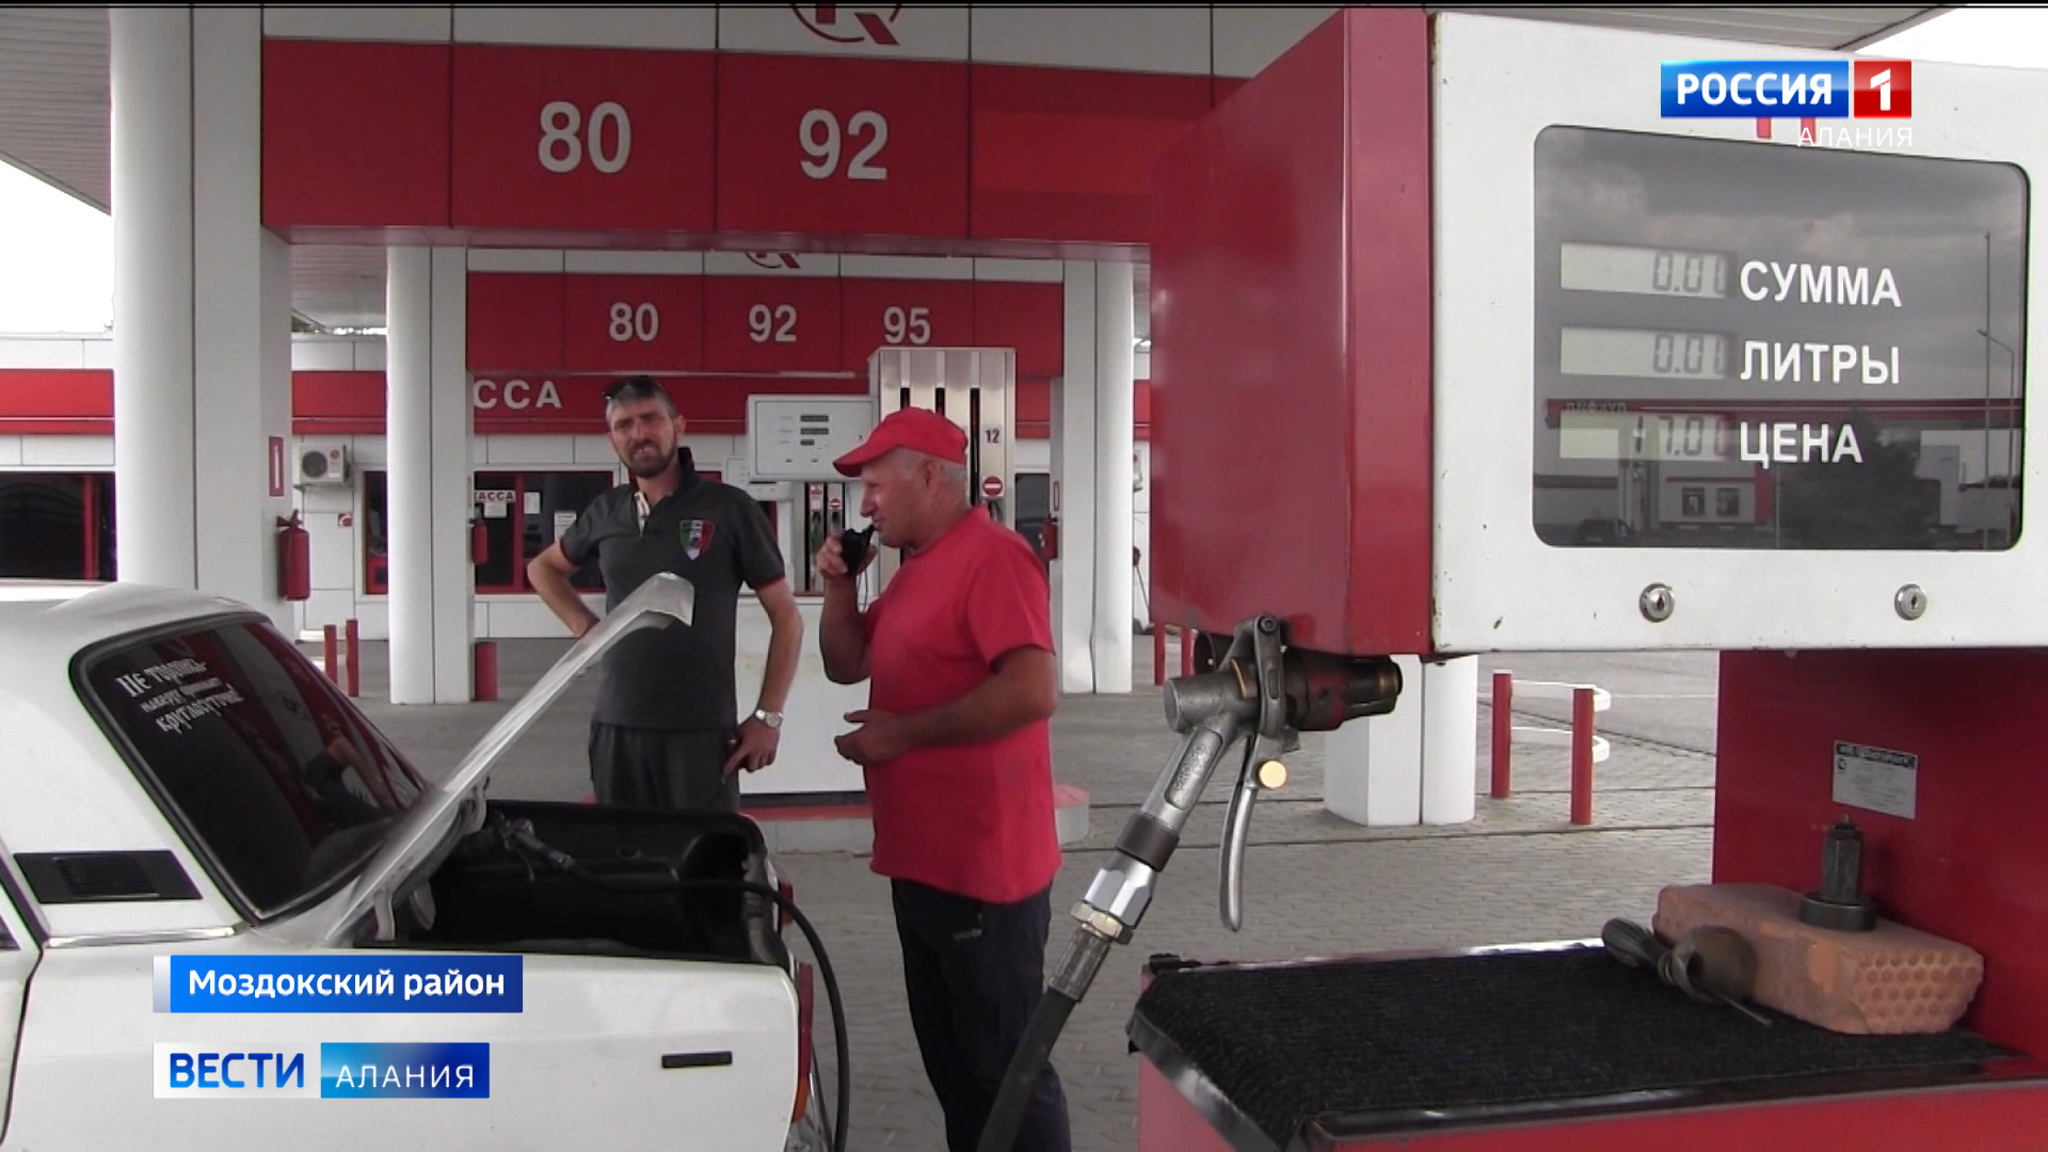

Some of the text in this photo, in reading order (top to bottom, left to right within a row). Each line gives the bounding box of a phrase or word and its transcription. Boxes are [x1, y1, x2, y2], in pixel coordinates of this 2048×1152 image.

[538, 101, 632, 173] 80
[799, 108, 888, 179] 92
[1740, 260, 1902, 308] СУММА
[609, 302, 659, 341] 80
[749, 304, 797, 342] 92
[883, 306, 931, 344] 95
[1740, 340, 1899, 385] ЛИТРЫ
[985, 428, 1000, 443] 12
[1740, 421, 1863, 469] ЦЕНА
